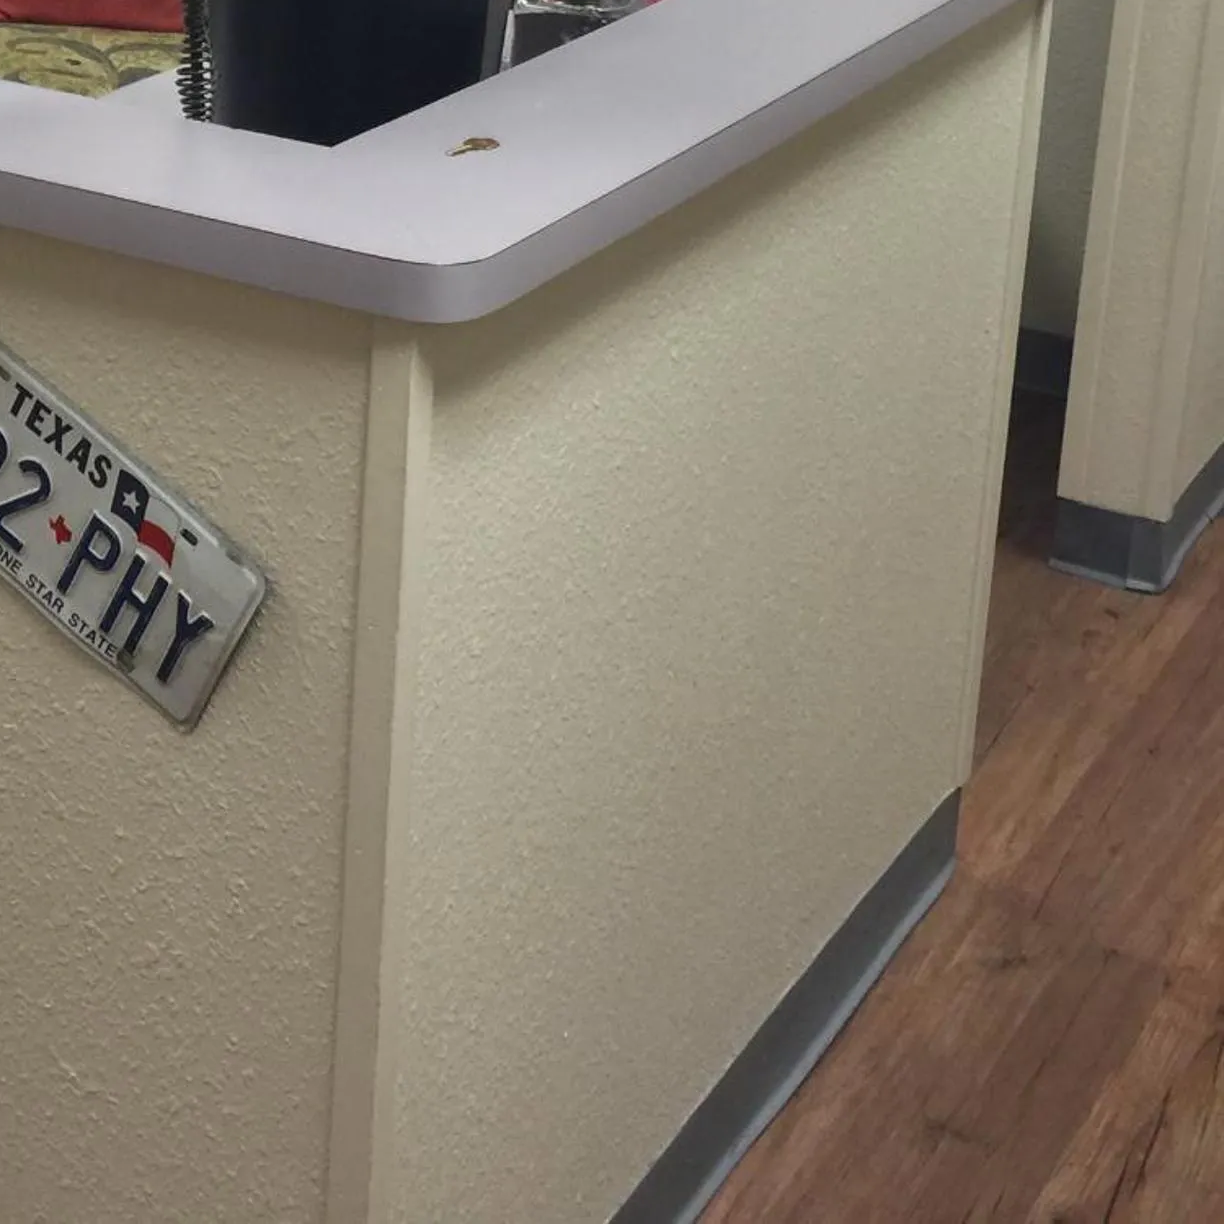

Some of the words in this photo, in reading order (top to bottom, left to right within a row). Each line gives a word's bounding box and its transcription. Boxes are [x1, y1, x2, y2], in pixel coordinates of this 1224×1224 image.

[9, 382, 112, 490] TEXAS
[25, 573, 65, 613] STAR
[67, 612, 119, 659] STATE
[55, 510, 215, 685] PHY
